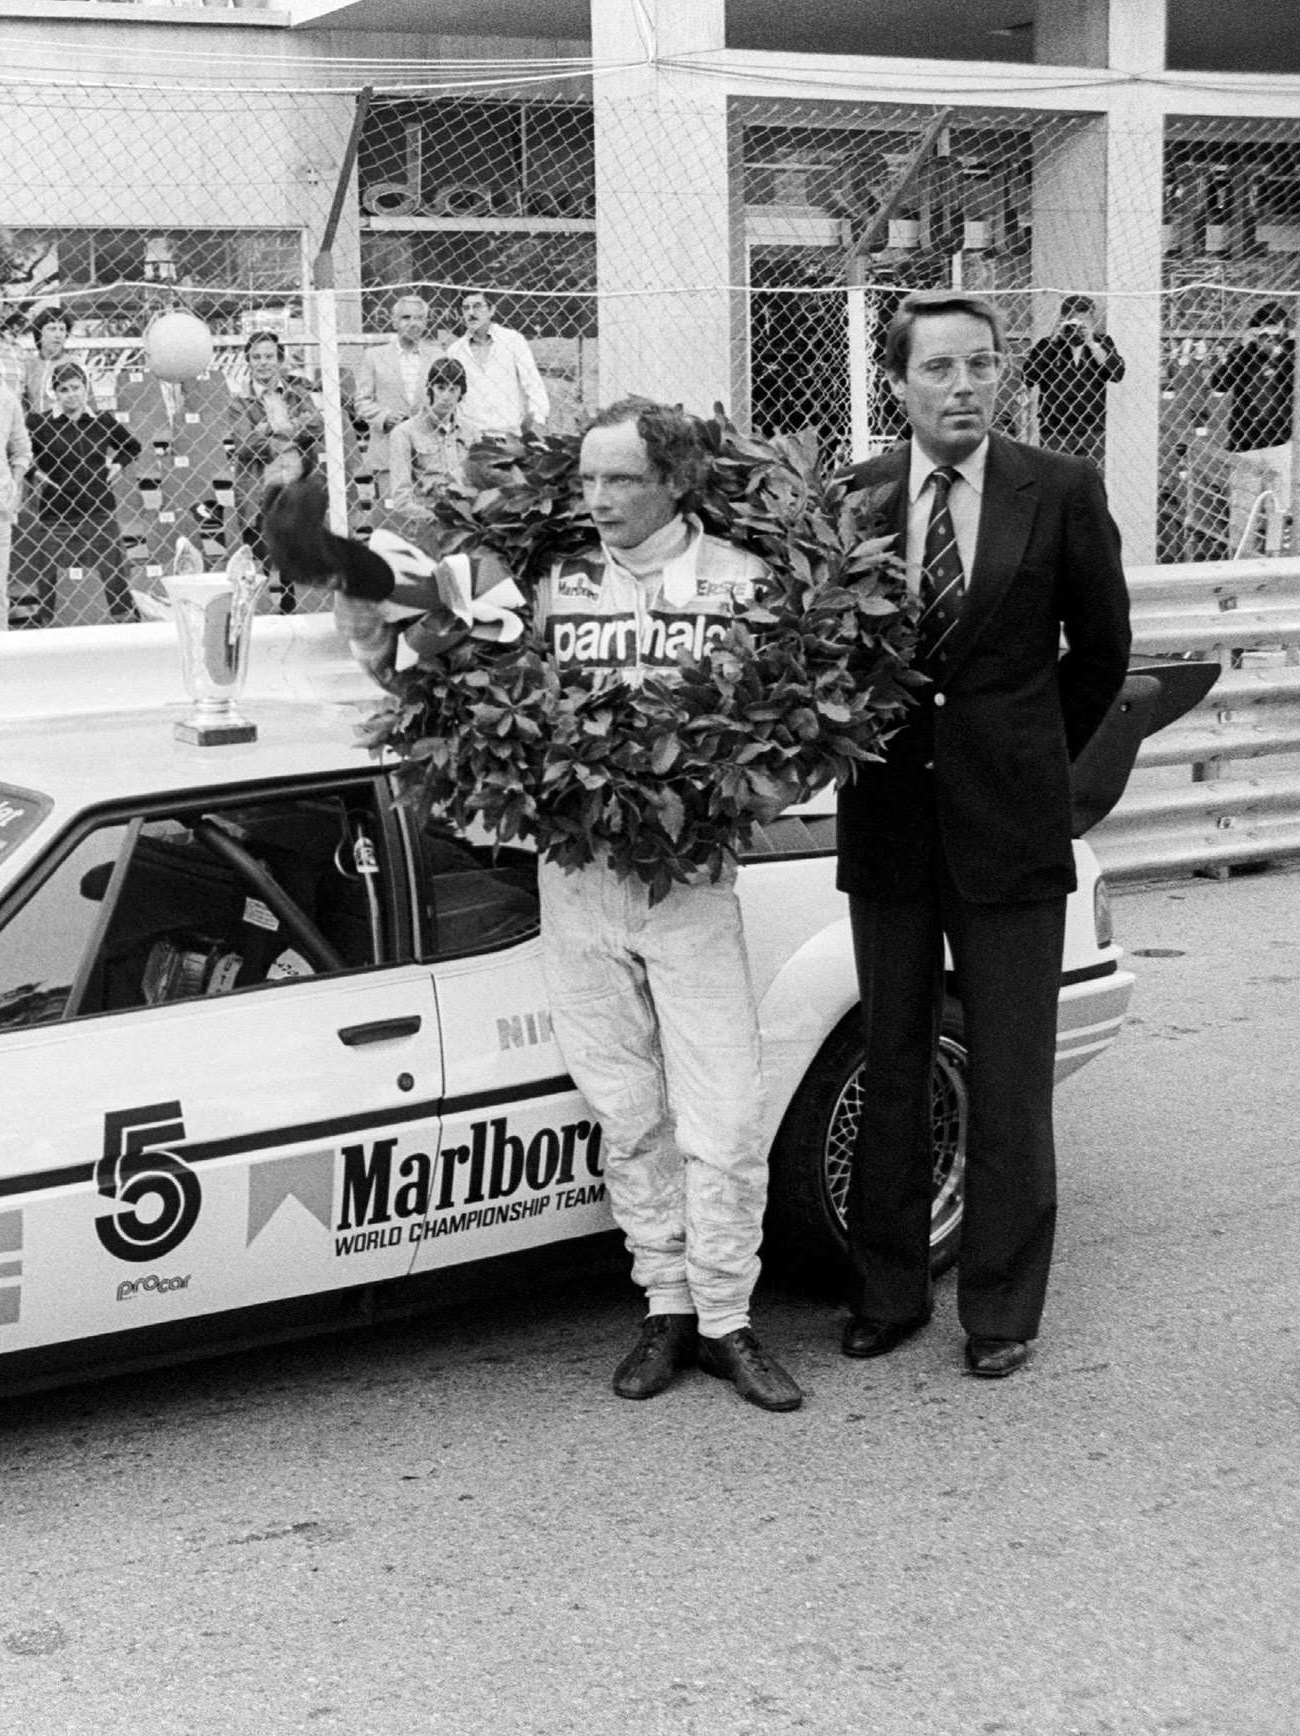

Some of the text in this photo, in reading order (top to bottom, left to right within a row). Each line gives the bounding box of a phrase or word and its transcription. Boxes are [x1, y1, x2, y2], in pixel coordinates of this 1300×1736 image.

[553, 613, 729, 663] parmala
[94, 1099, 202, 1263] 5
[335, 1182, 606, 1257] WORLD CHAMPIONSHIP TEAM
[116, 1273, 191, 1301] procar
